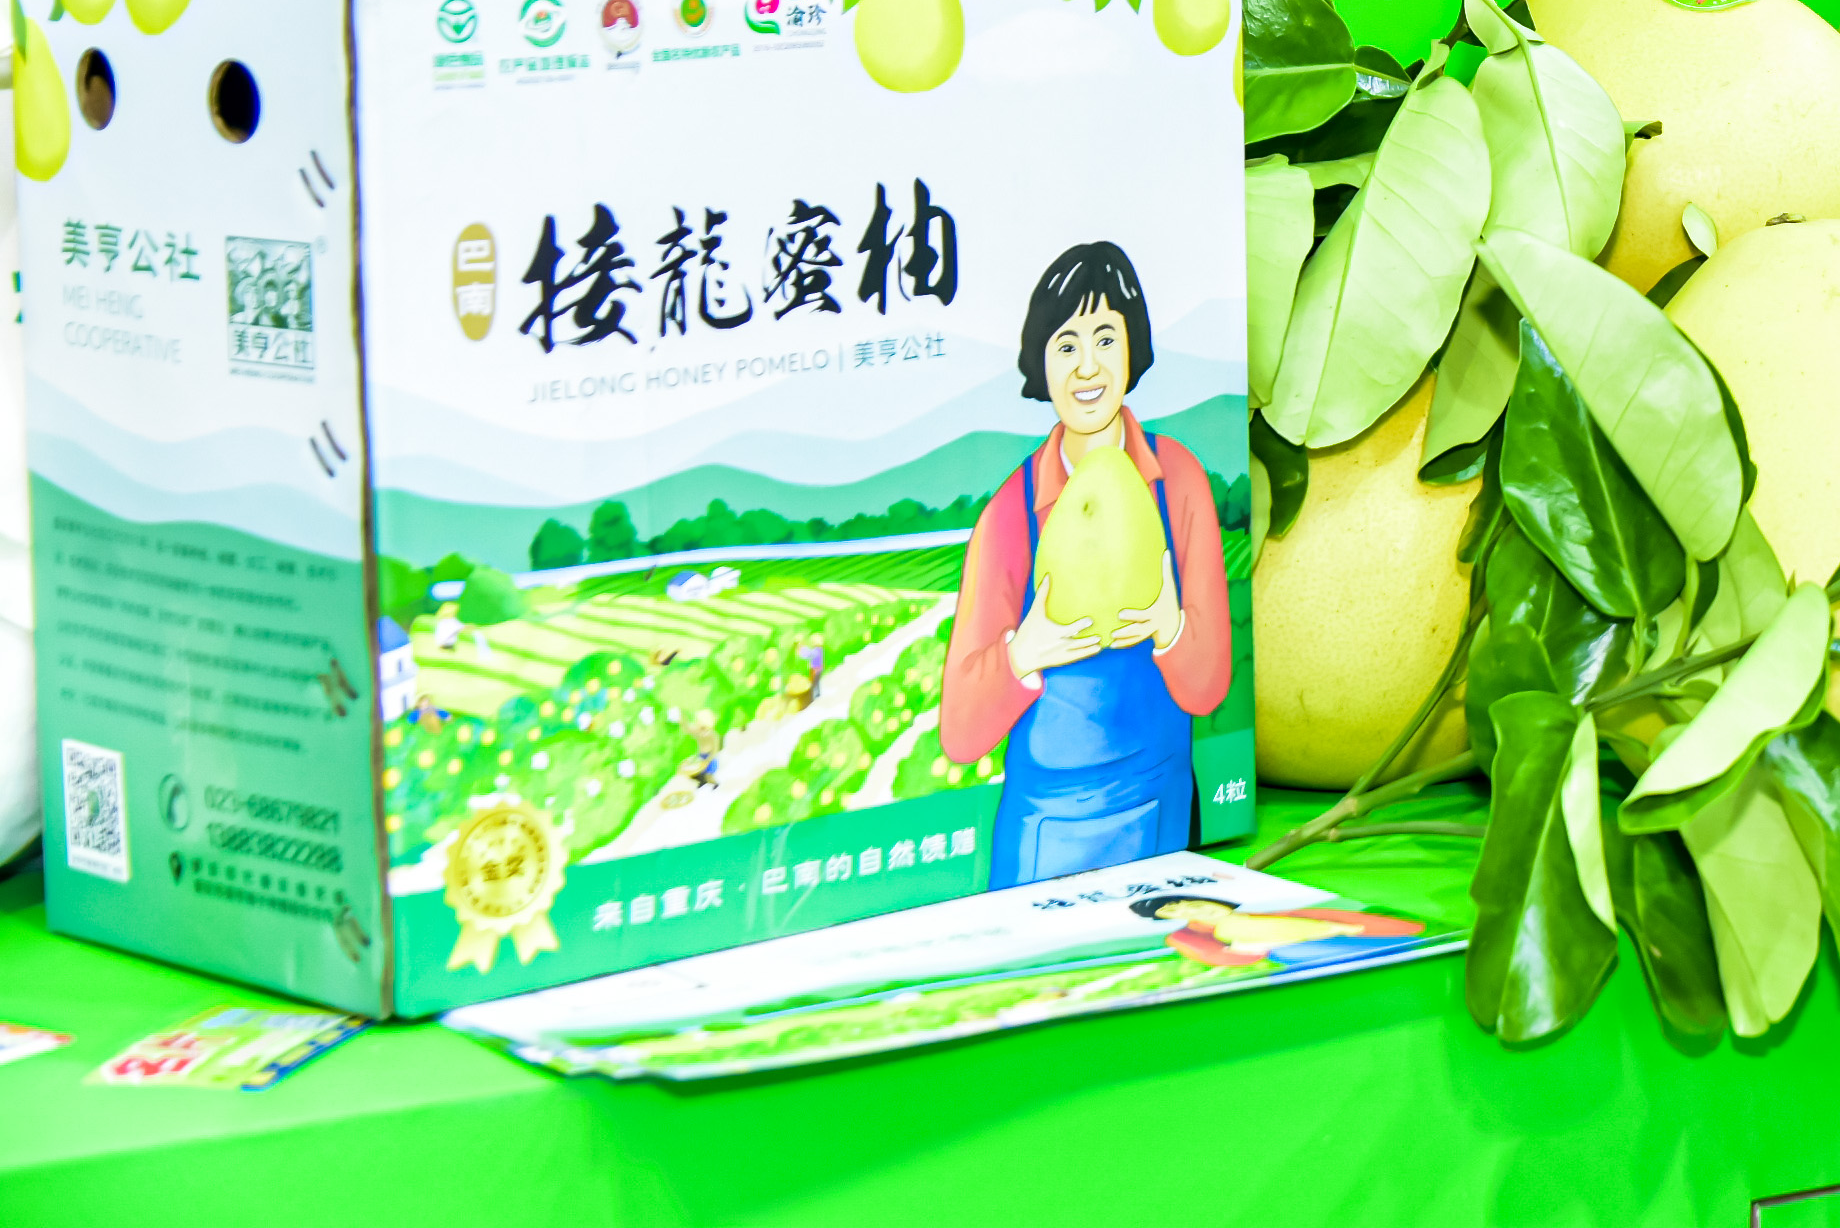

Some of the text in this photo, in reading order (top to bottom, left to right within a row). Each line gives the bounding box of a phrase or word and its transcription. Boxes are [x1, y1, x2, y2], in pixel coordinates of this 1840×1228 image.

[62, 219, 200, 282] 美亨公社
[455, 239, 496, 318] 巴南
[527, 348, 830, 406] JIELONG HONEY POMELO
[853, 331, 947, 368] 美亨公社
[1212, 777, 1248, 805] 4粒
